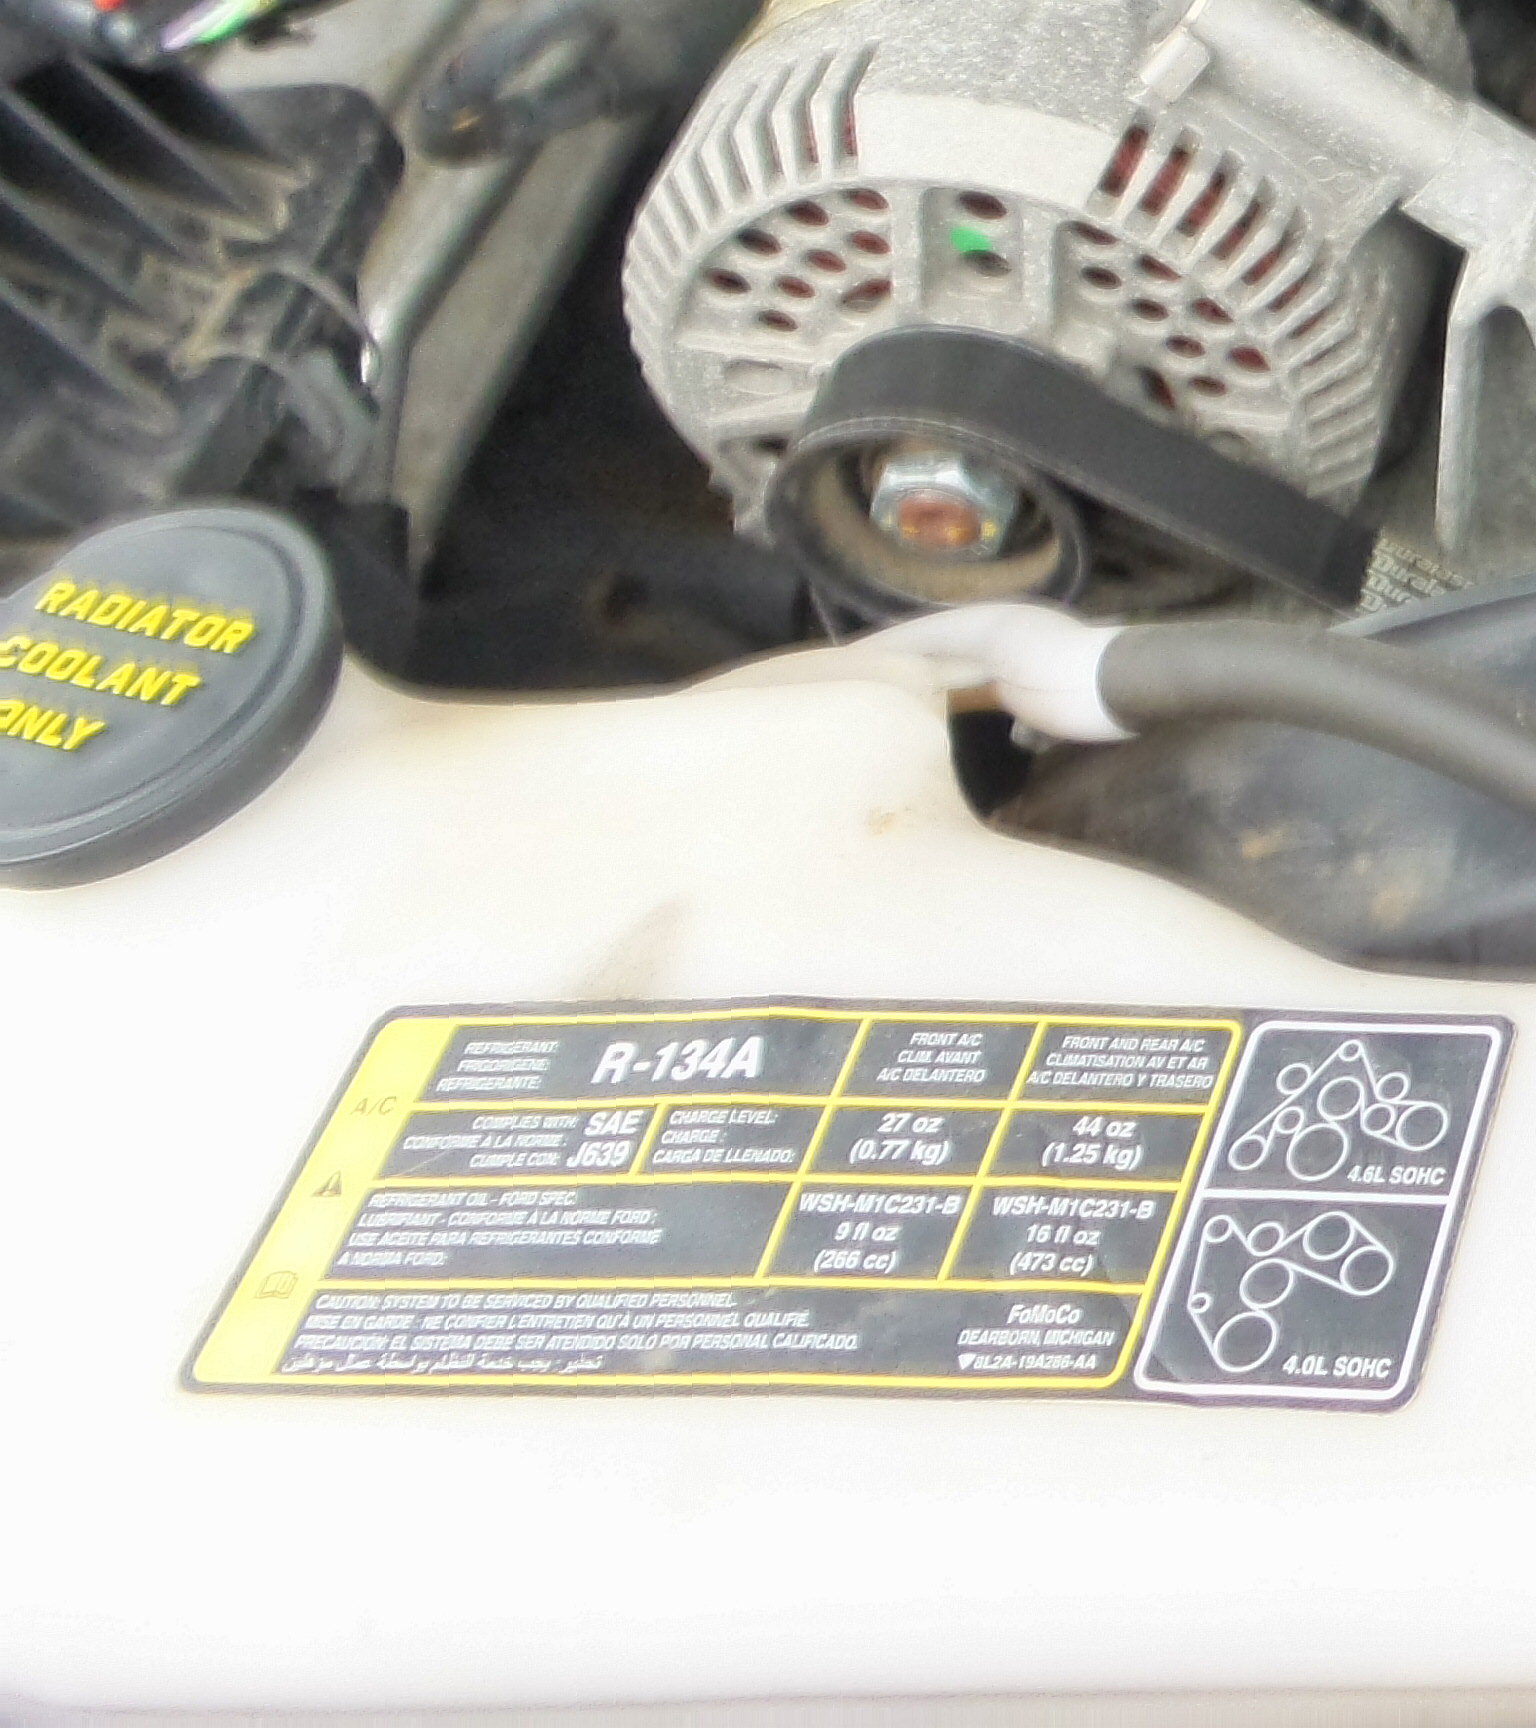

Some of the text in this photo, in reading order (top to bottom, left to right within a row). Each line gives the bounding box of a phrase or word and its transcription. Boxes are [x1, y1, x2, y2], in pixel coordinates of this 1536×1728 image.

[35, 582, 255, 654] RADIATOR
[0, 634, 202, 706] COOLANT
[909, 1032, 984, 1046] FRONT A/C
[1062, 1036, 1206, 1053] FRONT AND REAR A/C
[590, 1036, 765, 1084] R-134A
[934, 1050, 982, 1064] AVANT
[1046, 1053, 1209, 1070] CLIMATISATION AV ET AR
[876, 1068, 986, 1083] A/C DELANTERO
[1026, 1071, 1214, 1089] A/C DELANTERO Y TRASERO
[351, 1096, 396, 1115] A/C
[472, 1116, 540, 1130] COMPLIES
[584, 1110, 644, 1136] SAE
[669, 1109, 778, 1125] CHARGE LEVEL:
[877, 1113, 945, 1133] 27 oz
[1072, 1116, 1137, 1138] 44 oz
[403, 1135, 479, 1150] CONFORME
[493, 1134, 512, 1148] LA
[470, 1152, 525, 1168] CUMPLE
[567, 1140, 631, 1167] J639
[653, 1148, 796, 1164] CARGA DE LLENADO:
[849, 1138, 950, 1165] (0.77 kg)
[1041, 1142, 1143, 1171] (1.25 kg)
[1347, 1165, 1446, 1185] 4.6L SOHC
[367, 1193, 467, 1208] REFRIGERANT
[466, 1192, 489, 1206] OIL
[499, 1191, 538, 1206] FORD
[799, 1192, 962, 1215] WSH-M1C231-B
[992, 1196, 1156, 1220] WSH-M1C231-B
[358, 1211, 441, 1227] LUBRIFIANT
[448, 1211, 528, 1226] CONFORME
[540, 1210, 560, 1225] LA
[560, 1210, 611, 1225] NORME
[349, 1229, 662, 1247] USE ACEITE PARA REFRIGERANTES CONFORME
[834, 1222, 900, 1241] 9 fl oz
[1026, 1224, 1102, 1246] 16 fl oz
[337, 1251, 350, 1265] A
[350, 1251, 403, 1266] NORMA
[813, 1249, 897, 1274] (266 cc)
[1009, 1251, 1095, 1277] (473 cc)
[382, 1294, 440, 1310] SYSTEM
[440, 1294, 461, 1309] TO
[461, 1294, 482, 1309] BE
[484, 1294, 551, 1309] SERVICED
[553, 1294, 573, 1309] BY
[576, 1293, 648, 1309] QUALIFIED
[303, 1314, 341, 1329] MISE
[340, 1314, 365, 1329] EN
[420, 1314, 444, 1329] NE
[444, 1314, 507, 1330] CONFIER
[633, 1314, 655, 1329] UN
[655, 1313, 740, 1328] PERSONNEL
[1006, 1303, 1083, 1324] FoMoCo
[389, 1334, 409, 1350] EL
[408, 1334, 472, 1350] SISTEMA
[472, 1334, 515, 1350] DEBE
[515, 1334, 546, 1350] SER
[545, 1334, 617, 1350] ATENDIDO
[617, 1333, 658, 1350] SOLO
[659, 1333, 692, 1349] POR
[692, 1333, 769, 1349] PERSONAL
[957, 1329, 1115, 1347] DEARBORN, MICHIGAN
[1282, 1355, 1392, 1378] 4.0L SOHC
